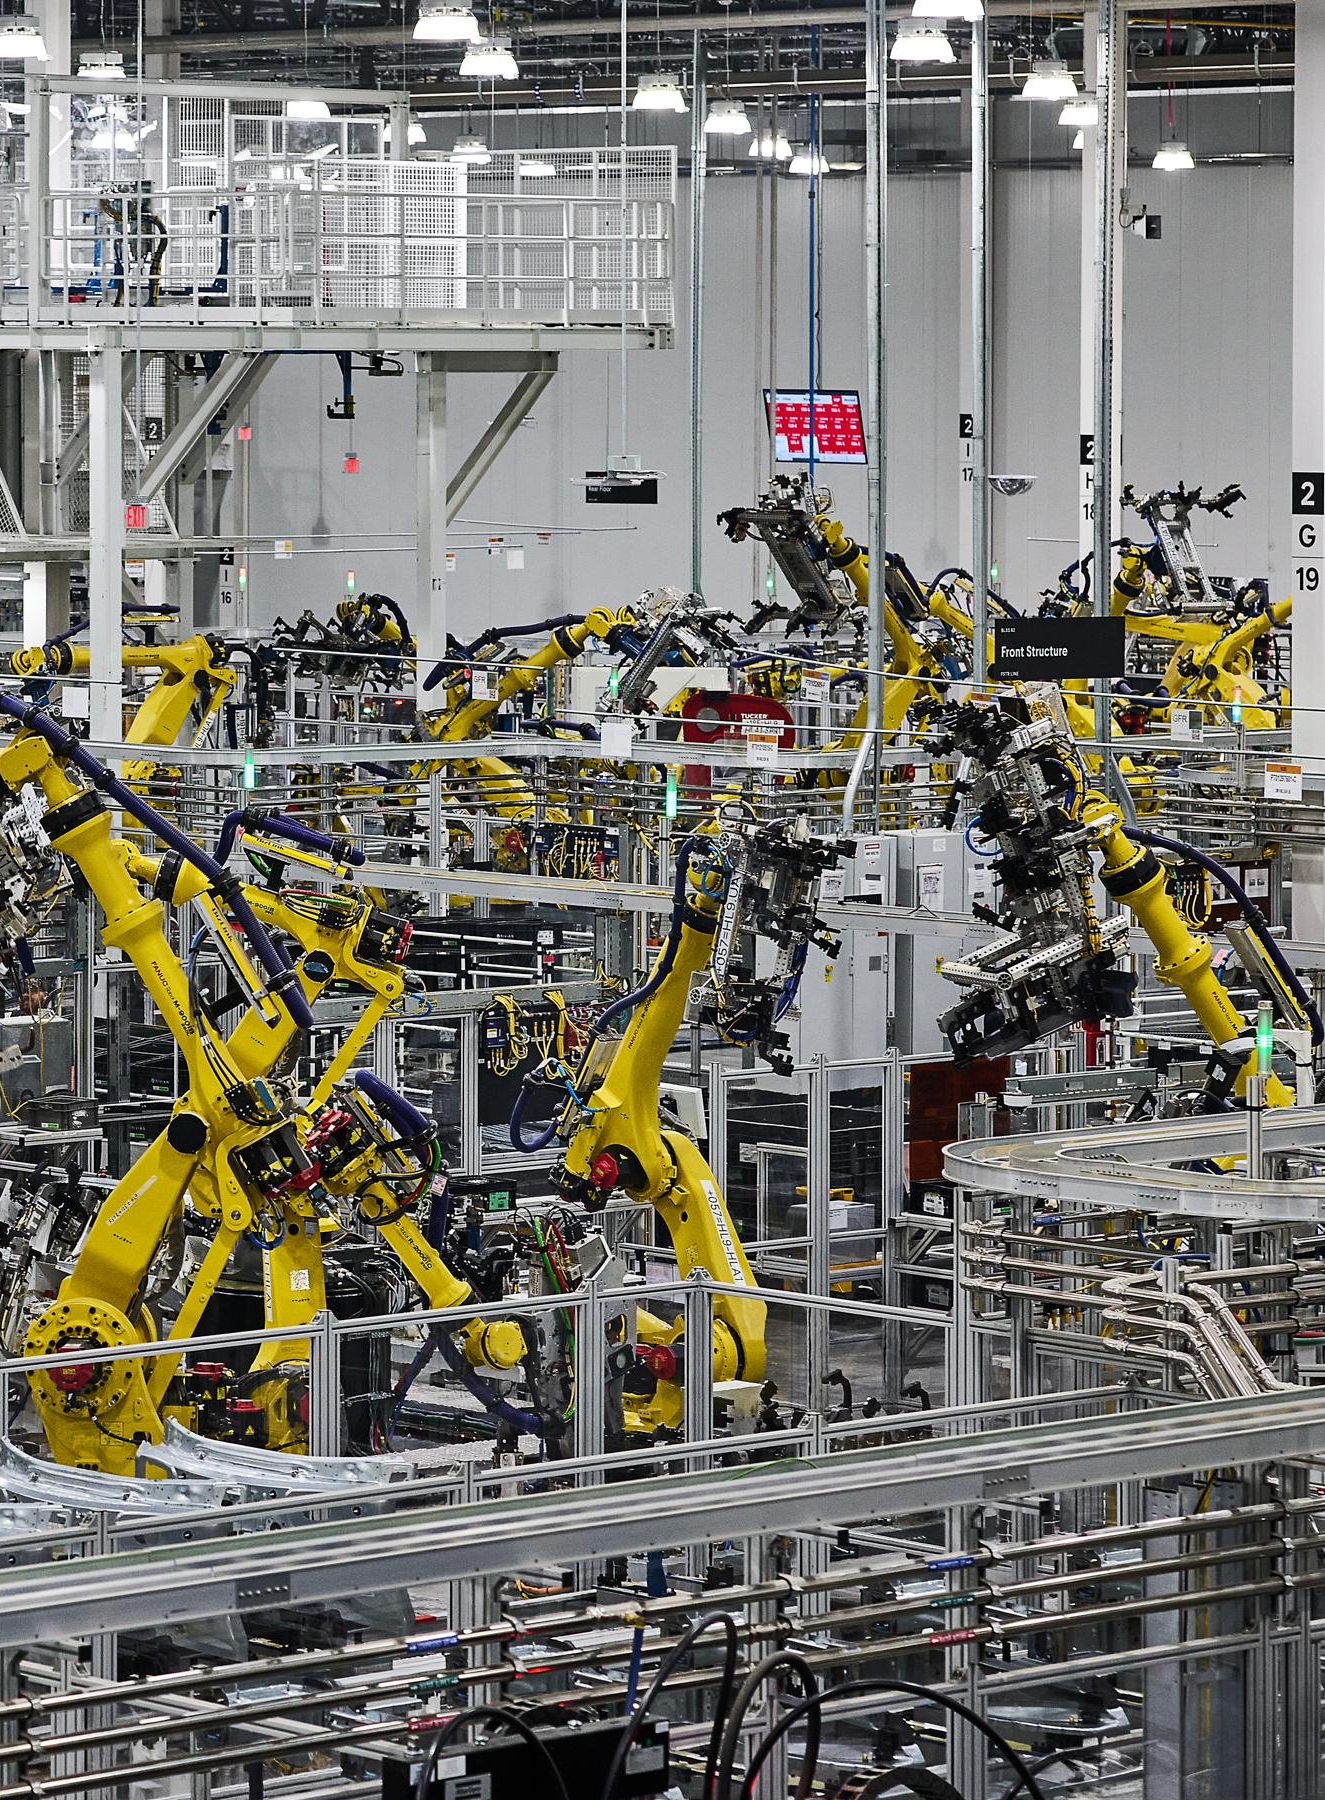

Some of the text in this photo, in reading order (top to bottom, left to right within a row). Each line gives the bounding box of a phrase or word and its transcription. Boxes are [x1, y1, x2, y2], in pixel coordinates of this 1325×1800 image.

[149, 423, 157, 438] 2
[964, 419, 973, 433] 2
[1300, 481, 1315, 506] 2
[127, 506, 146, 528] EXIT
[1299, 524, 1316, 548] G
[223, 548, 230, 560] 2
[1296, 567, 1319, 591] 19
[221, 591, 232, 604] 16
[1001, 645, 1069, 658] Front Structure
[1173, 714, 1187, 723] GFR
[151, 961, 168, 987] FANUC
[173, 1000, 195, 1034] M-900iB
[1212, 991, 1226, 1013] FANUC
[628, 1029, 638, 1049] FANUC
[708, 1190, 743, 1281] +057=HL9-HLA1
